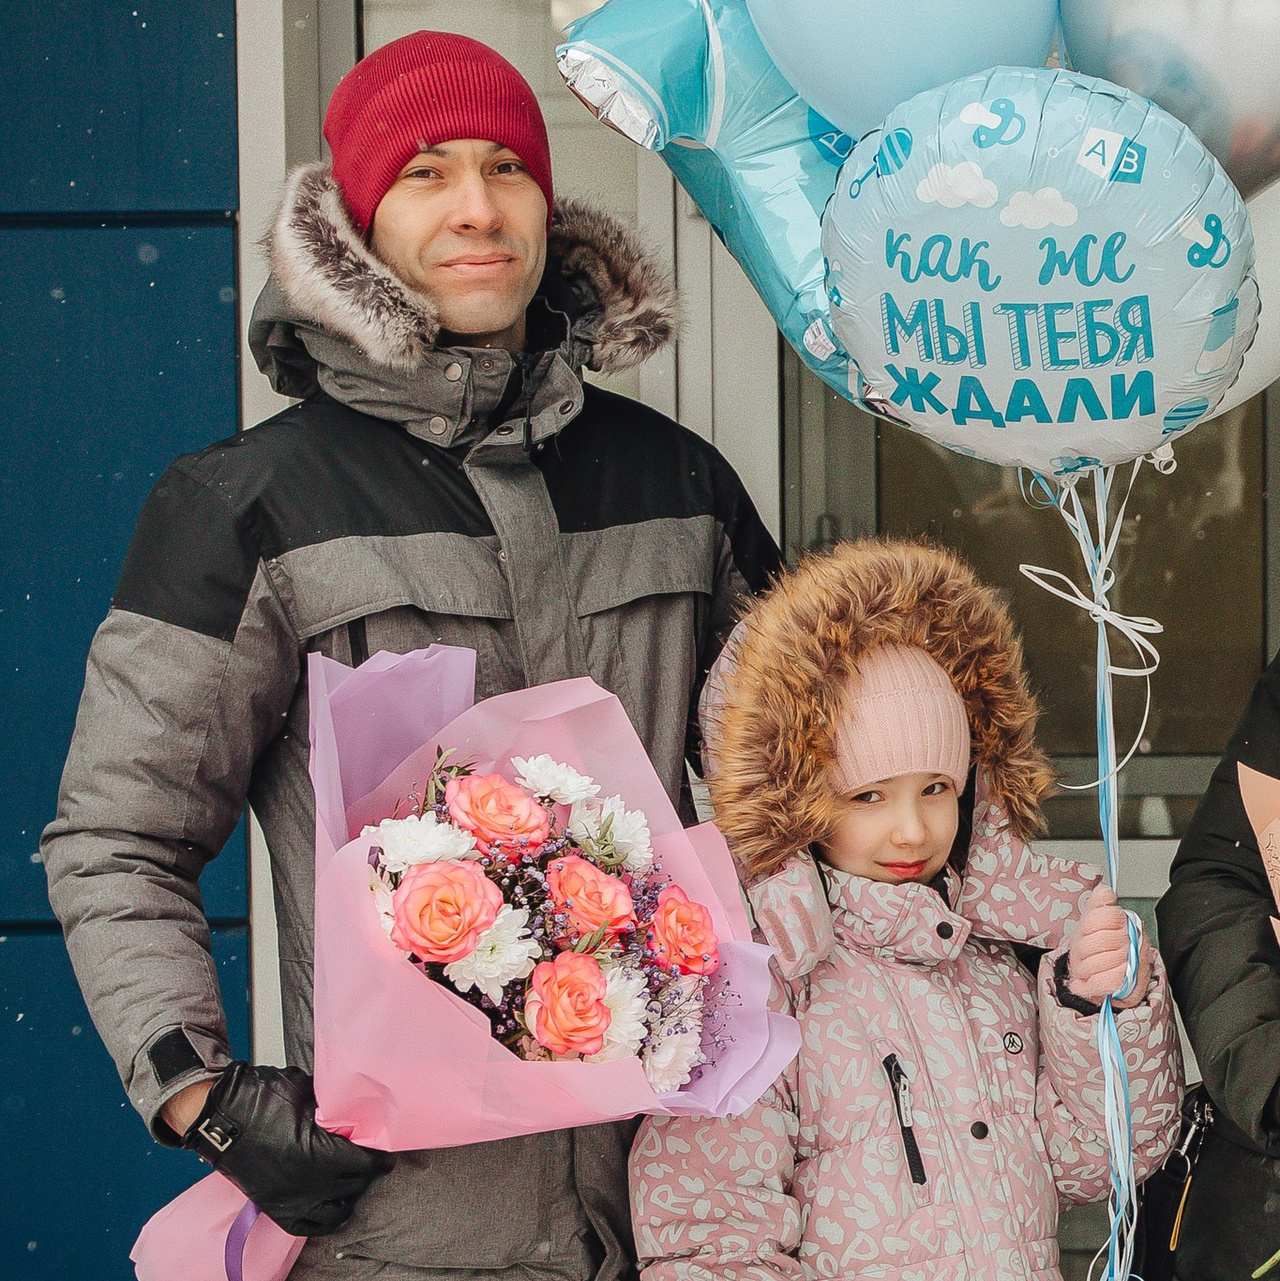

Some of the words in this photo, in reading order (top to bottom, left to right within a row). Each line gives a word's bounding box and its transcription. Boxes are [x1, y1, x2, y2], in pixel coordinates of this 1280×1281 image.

[885, 229, 1002, 291] как
[1038, 231, 1136, 286] же
[880, 292, 987, 369] МЫ
[992, 295, 1154, 372] ТЕБЯ
[884, 364, 1157, 428] ЖДАЛИ
